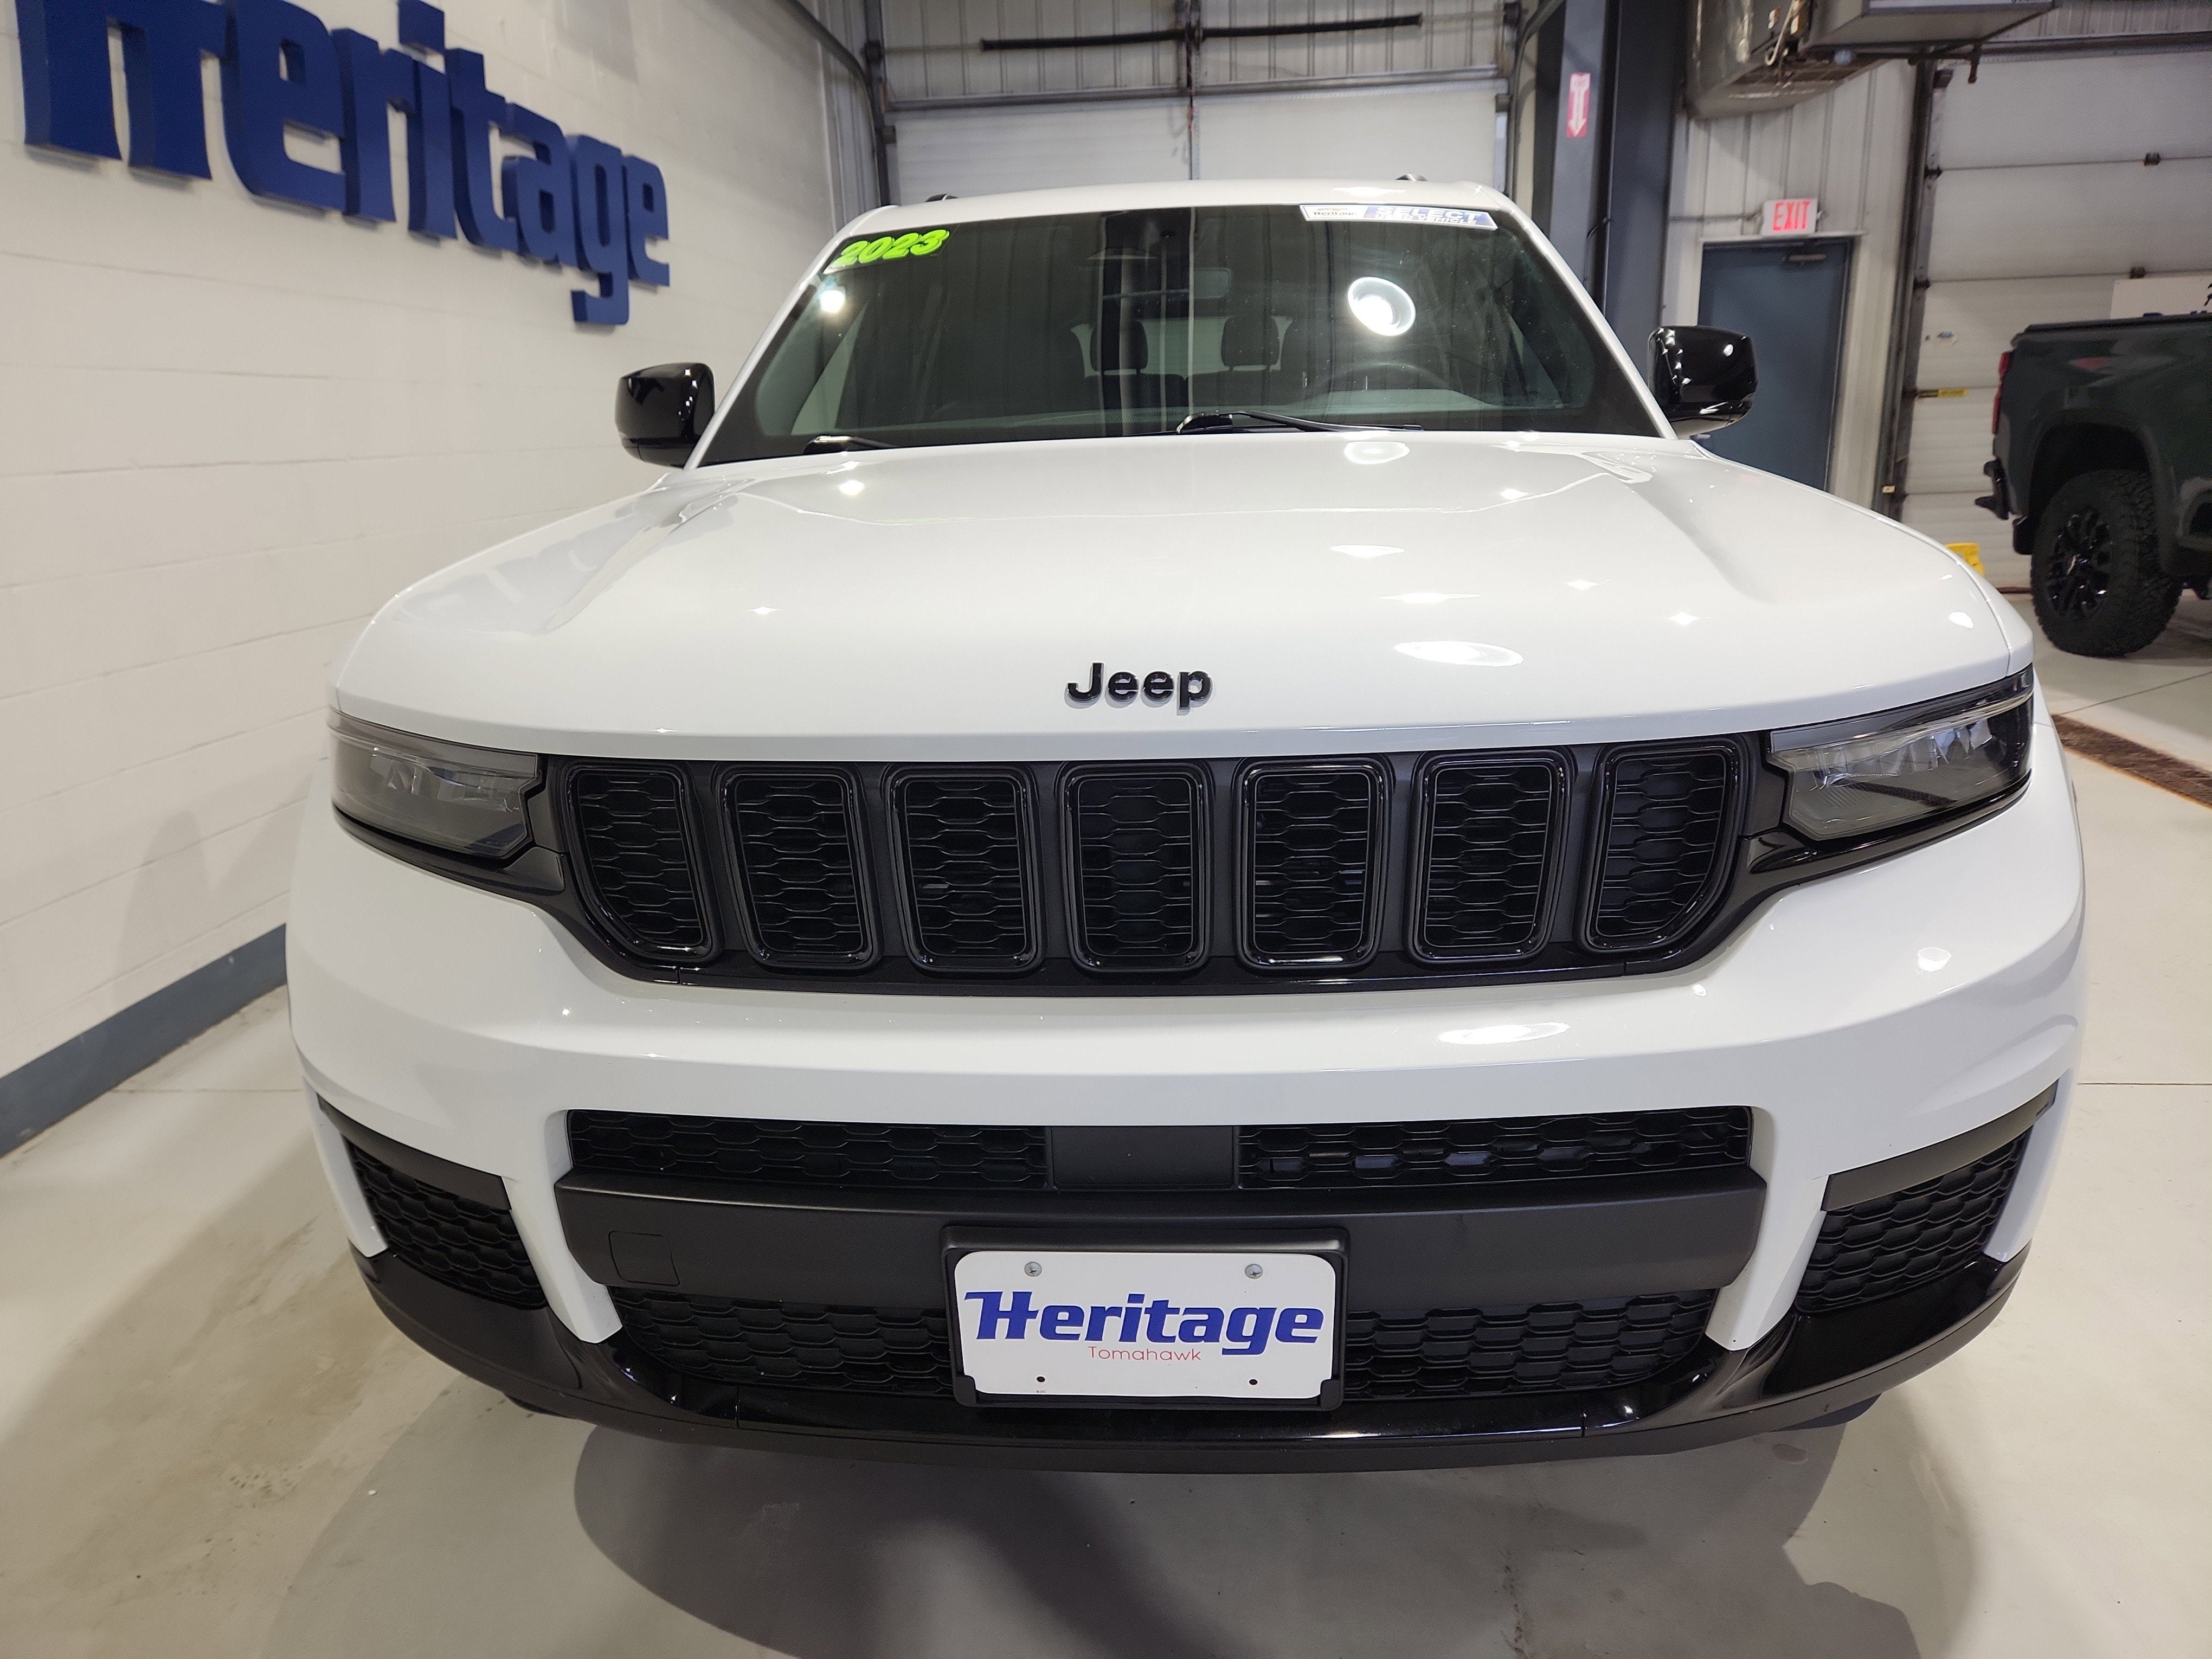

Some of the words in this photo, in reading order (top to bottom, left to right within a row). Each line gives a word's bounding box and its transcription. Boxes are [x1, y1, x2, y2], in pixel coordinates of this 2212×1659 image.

[1375, 207, 1482, 221] SELECT
[1418, 216, 1478, 224] VEHICLE
[1772, 201, 1811, 231] EXIT
[831, 229, 950, 266] 2023
[1066, 662, 1212, 710] Jeep
[964, 1291, 1324, 1355] Heritage
[1088, 1346, 1201, 1360] Tomahawk
